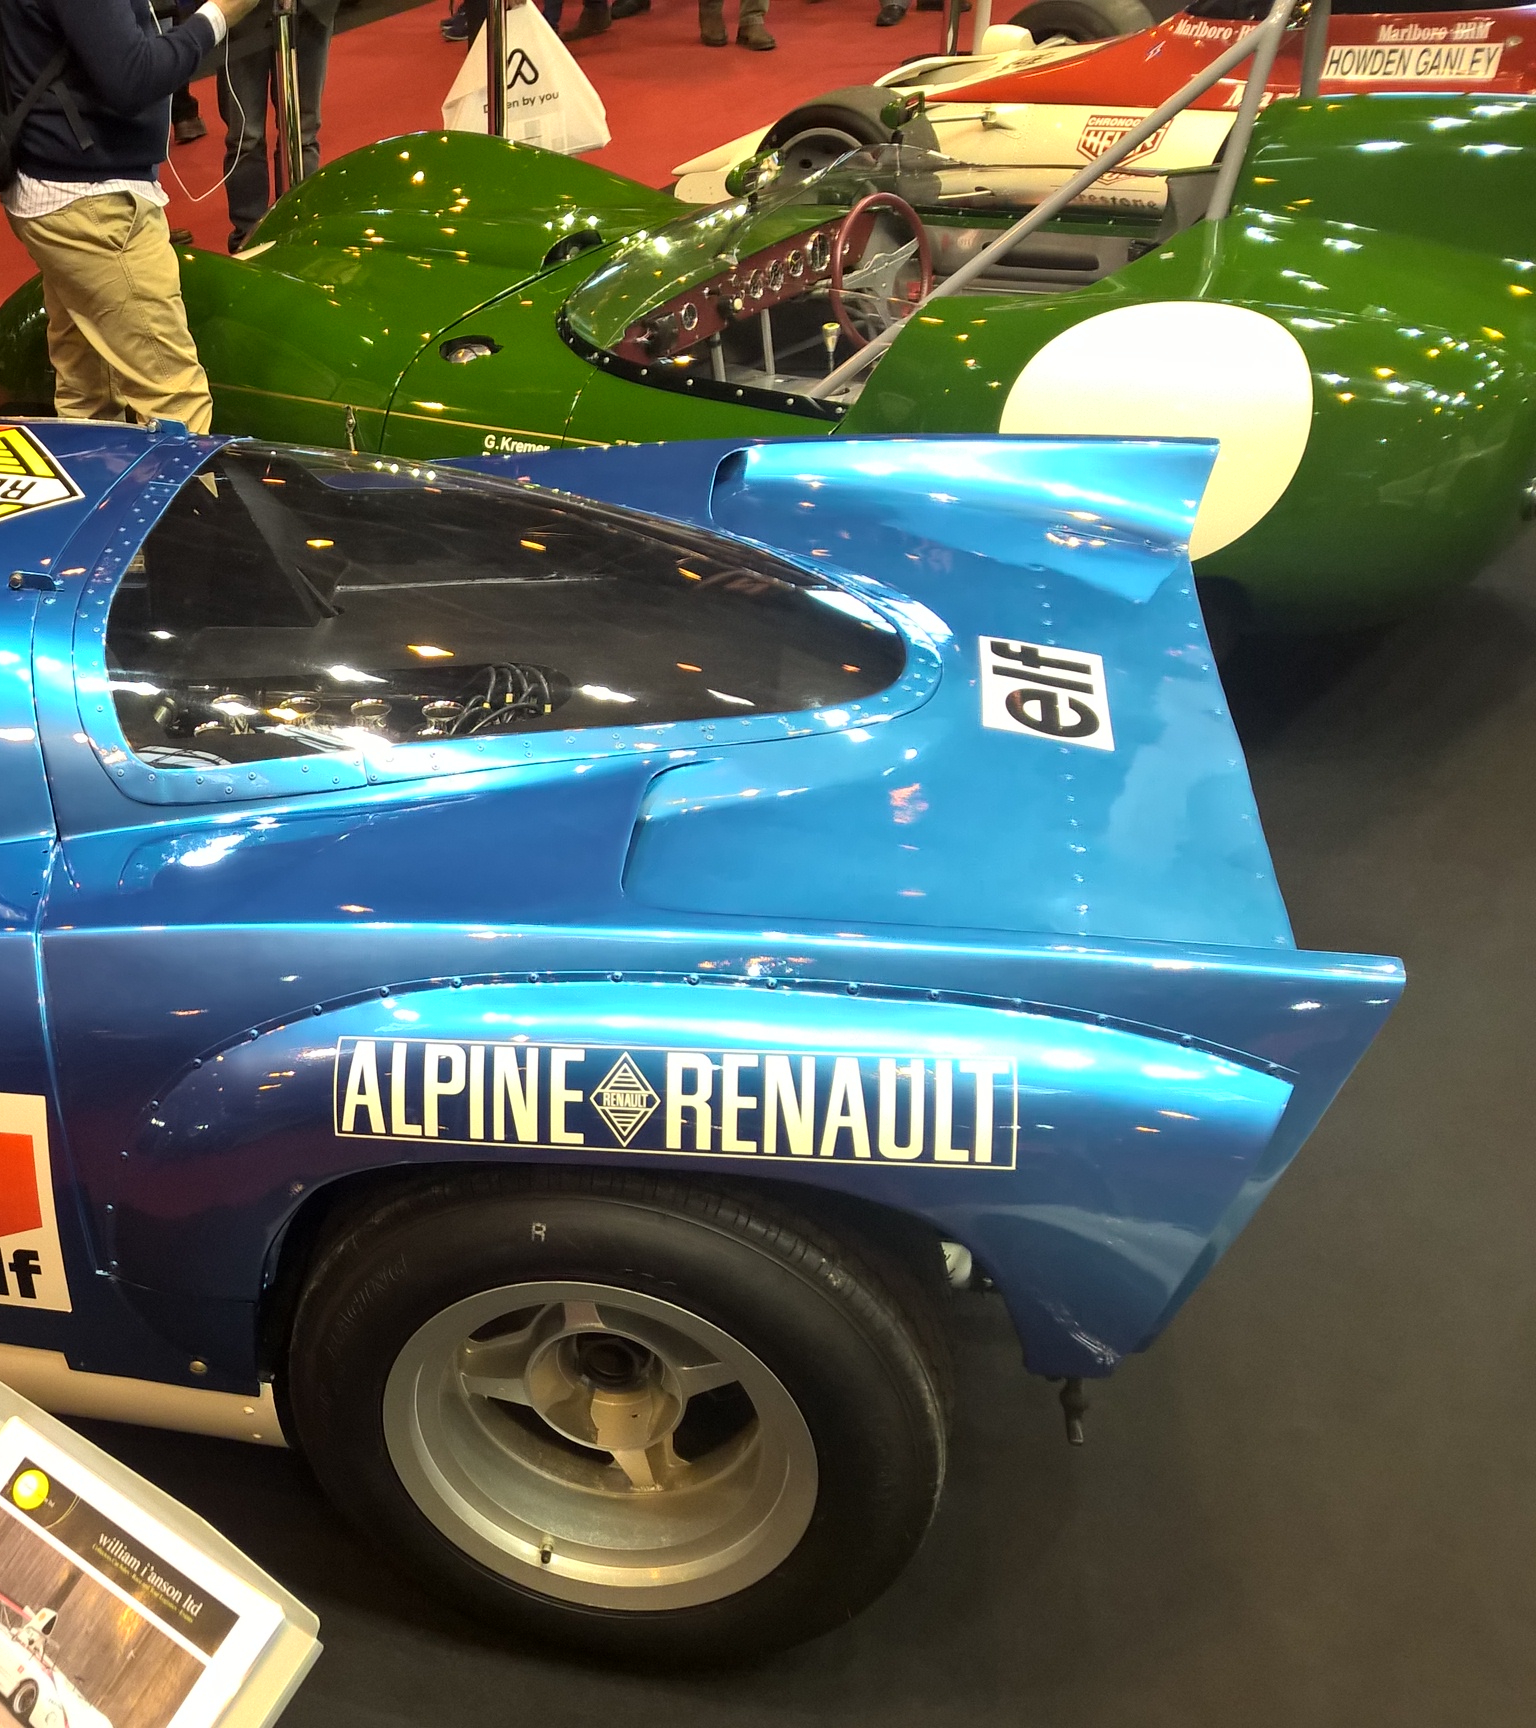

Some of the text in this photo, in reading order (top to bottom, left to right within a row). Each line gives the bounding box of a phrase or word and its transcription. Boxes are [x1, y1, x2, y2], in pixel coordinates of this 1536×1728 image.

[1173, 18, 1234, 40] Marlboro
[1325, 46, 1499, 77] HOWDEN GANLEY
[522, 96, 536, 107] by
[539, 91, 560, 104] you
[990, 640, 1100, 738] elf
[341, 1040, 586, 1145] ALPINE
[602, 1091, 649, 1108] RENAULT
[666, 1051, 1010, 1164] RENAULT
[99, 1533, 203, 1617] william i'anson ltd
